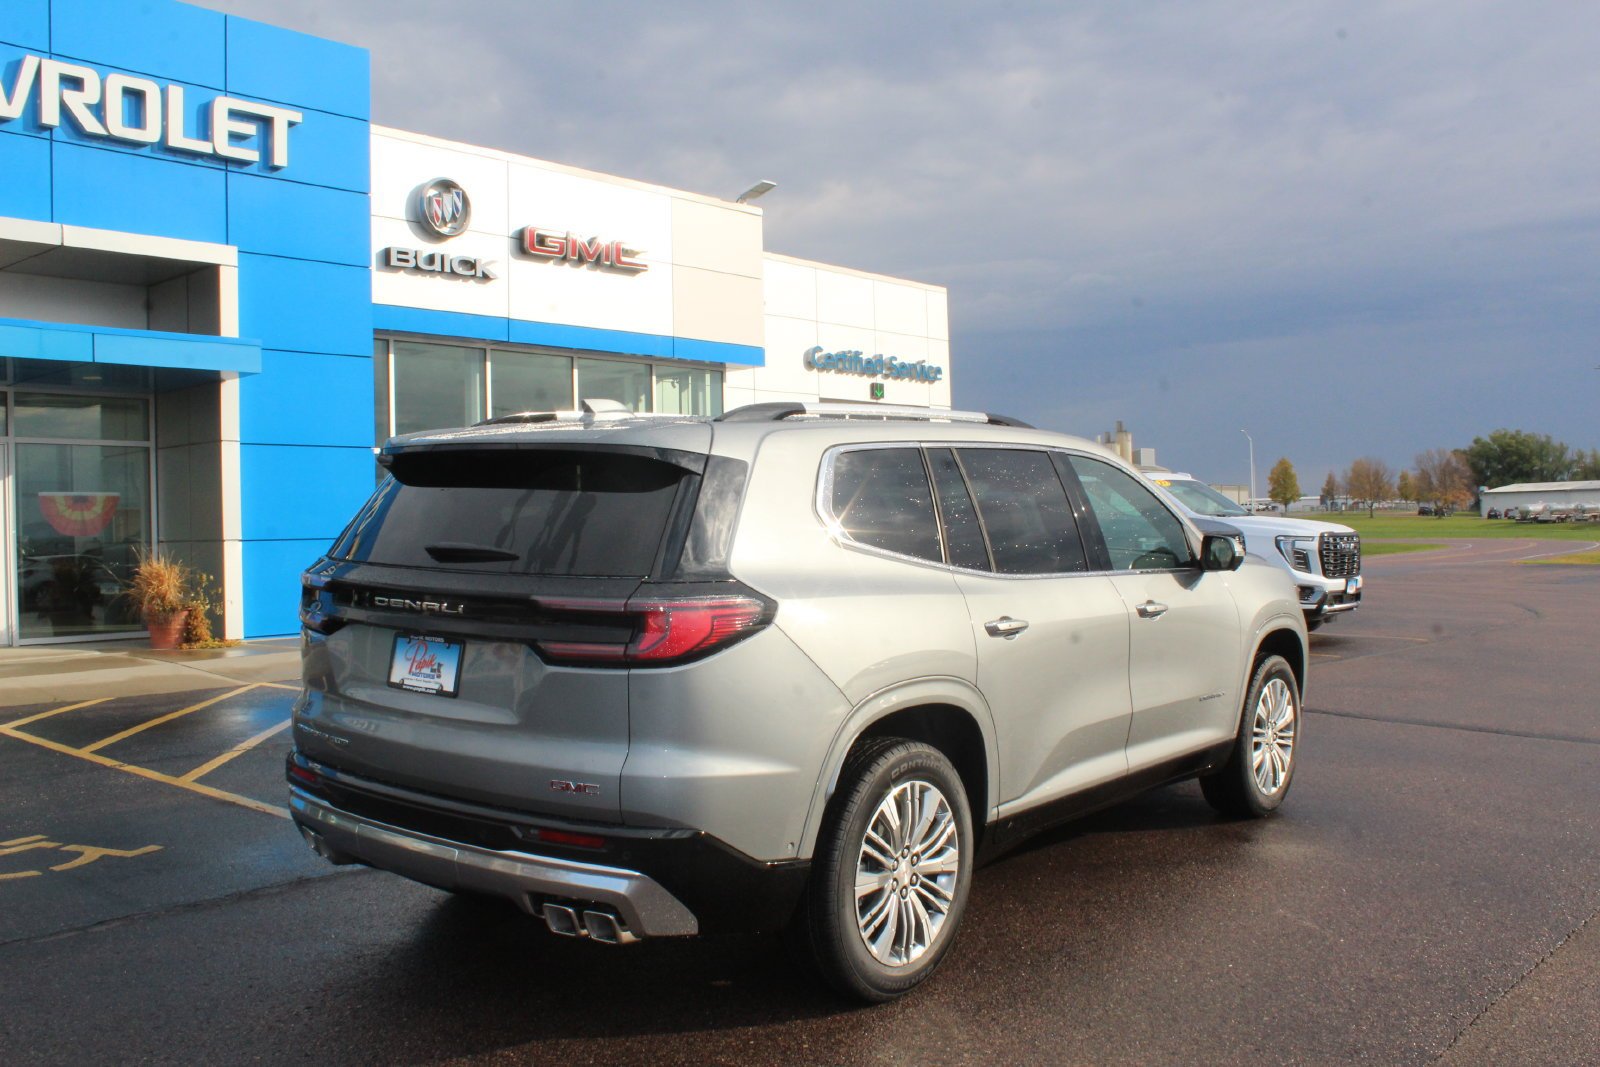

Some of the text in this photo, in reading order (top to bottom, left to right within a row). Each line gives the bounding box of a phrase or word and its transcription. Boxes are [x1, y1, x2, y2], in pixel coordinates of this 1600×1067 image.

[0, 54, 303, 167] VROLET
[387, 246, 499, 280] BUICK
[524, 225, 649, 272] GMC
[806, 345, 943, 383] Certified Service
[374, 596, 464, 614] DENALI
[551, 779, 600, 795] GMC
